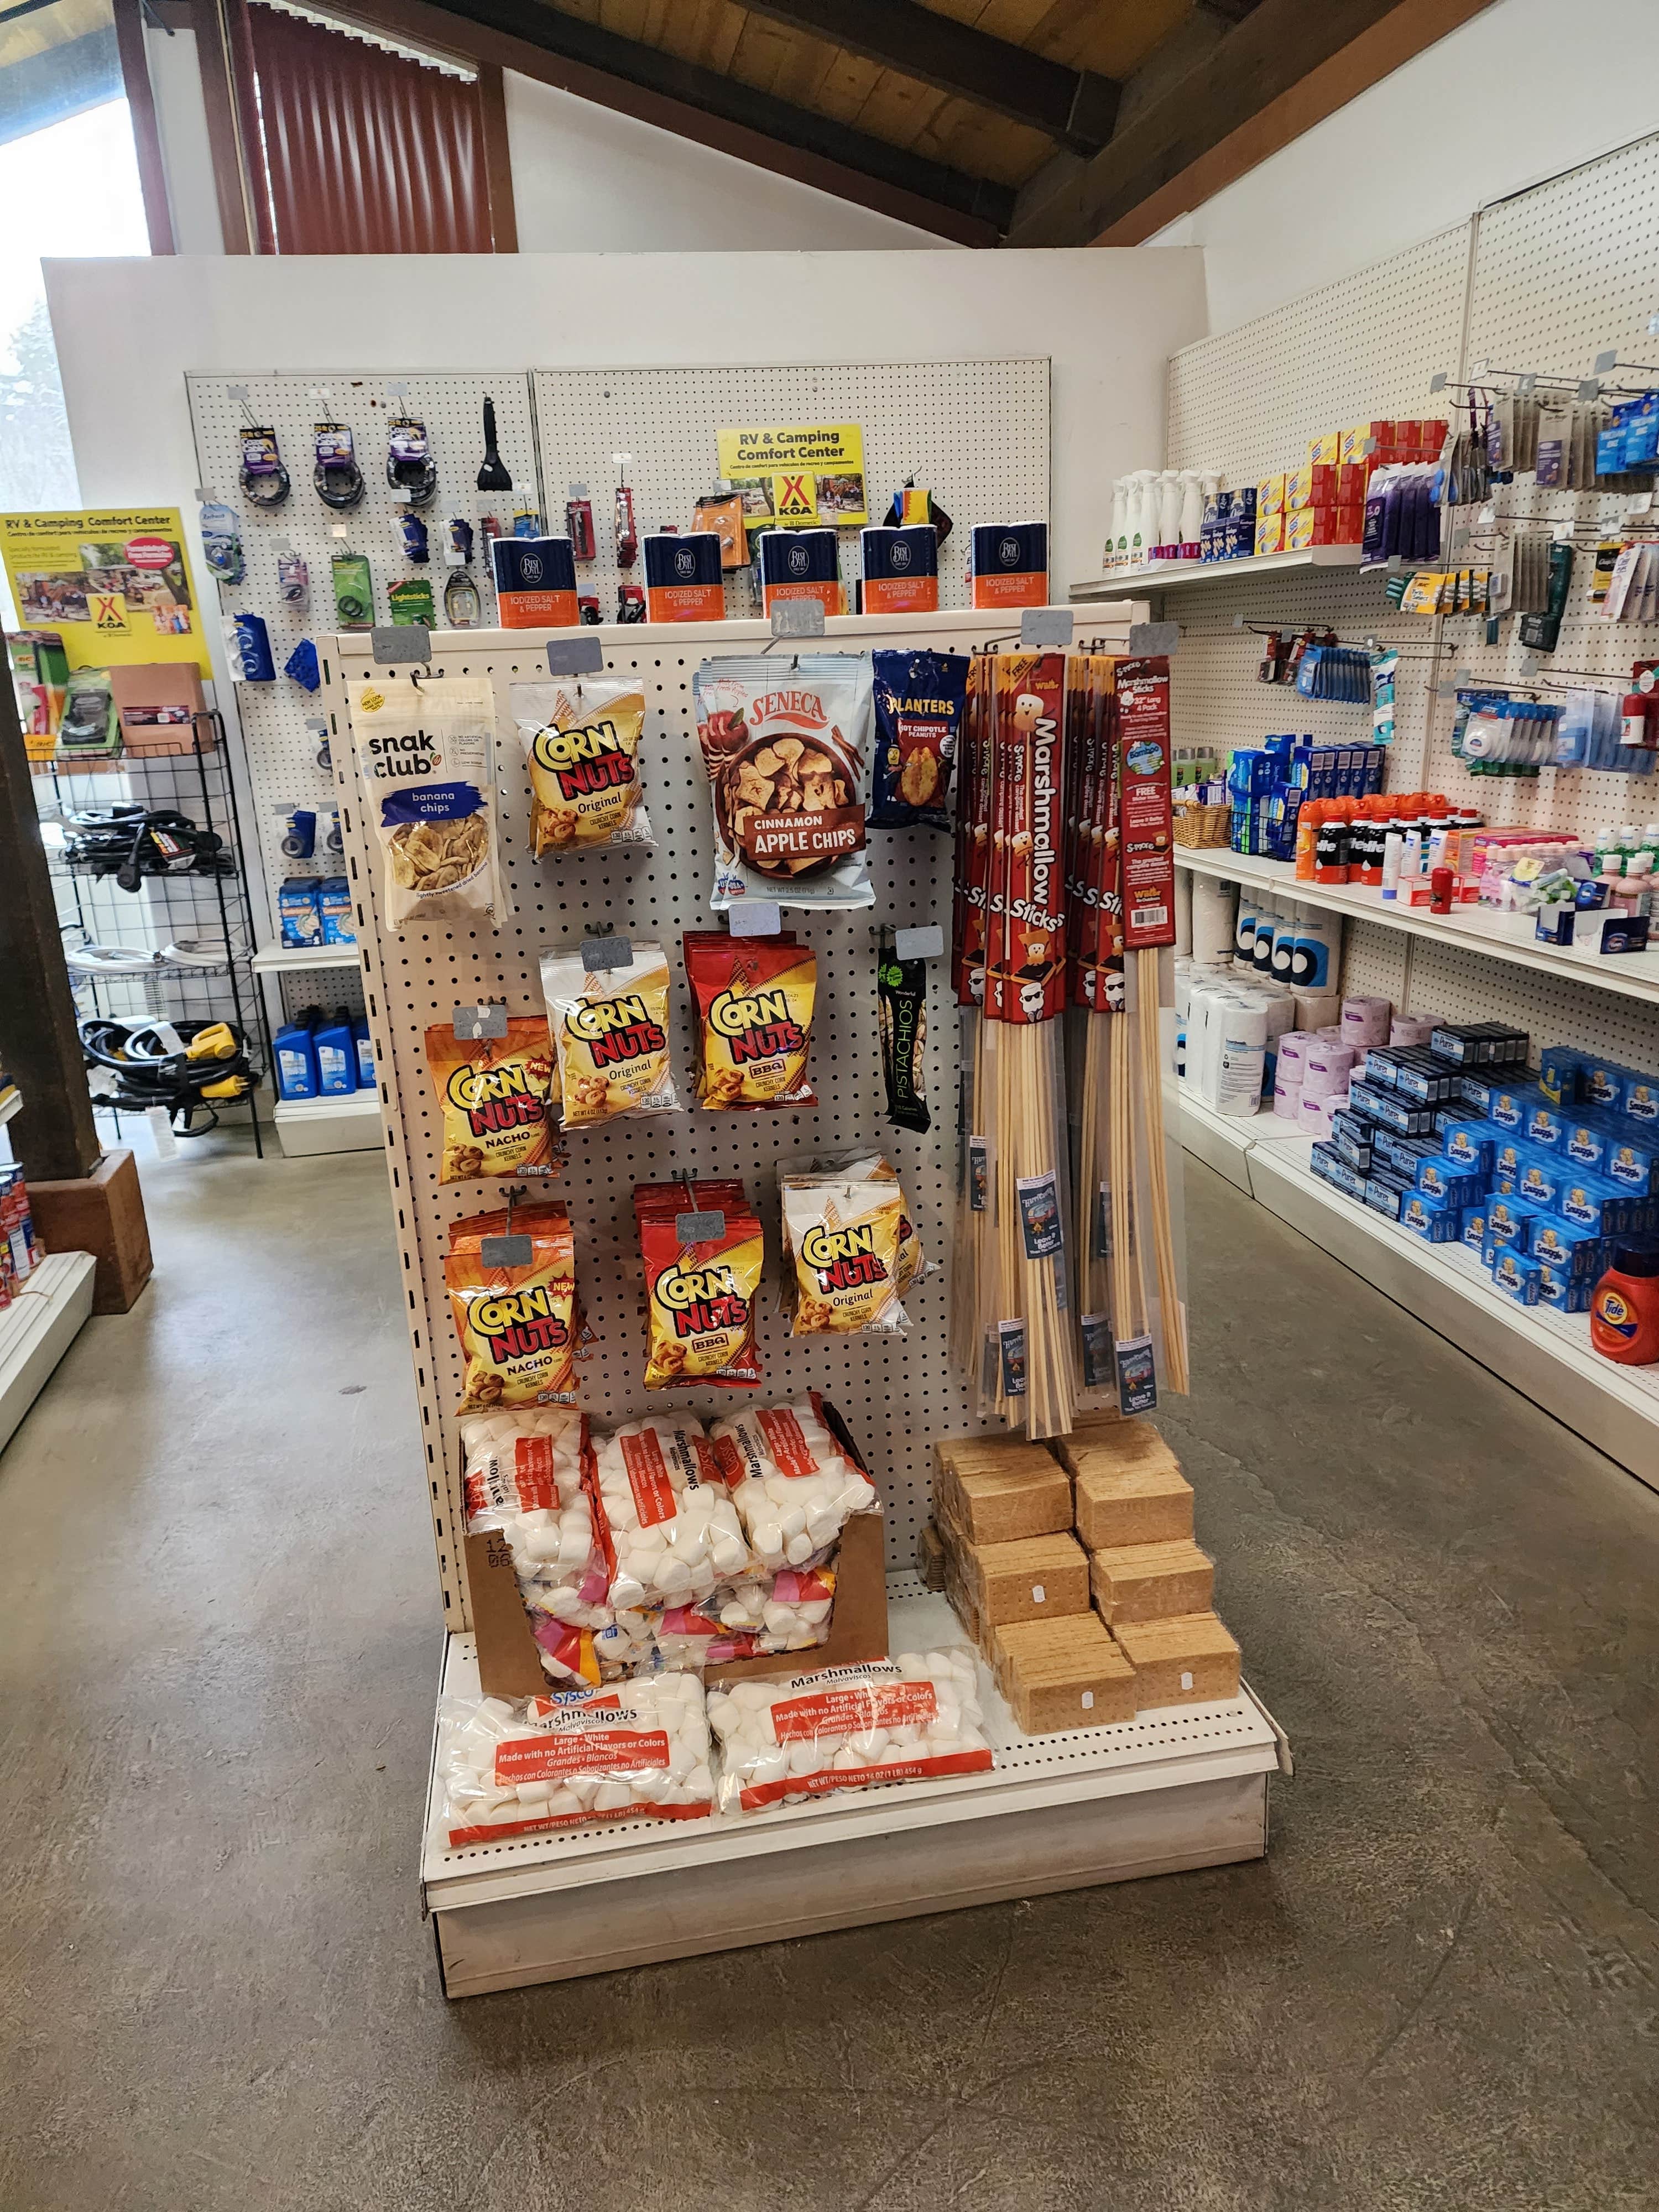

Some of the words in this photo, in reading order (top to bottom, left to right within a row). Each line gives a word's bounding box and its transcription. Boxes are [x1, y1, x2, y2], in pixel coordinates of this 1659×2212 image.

[740, 434, 759, 445] RV
[763, 433, 774, 444] &
[777, 431, 839, 445] Camping
[738, 448, 795, 460] Comfort
[799, 447, 844, 457] Center
[779, 507, 812, 515] KOA
[6, 520, 20, 529] RV
[35, 518, 83, 528] Camping
[88, 516, 133, 525] Comfort
[135, 516, 170, 525] Center
[776, 588, 805, 596] IODIZED
[806, 586, 824, 594] SALT
[878, 582, 906, 591] IODIZED
[907, 581, 925, 589] SALT
[893, 589, 916, 598] PEPPER
[510, 596, 540, 604] IODIZED
[541, 595, 561, 603] SALT
[1012, 658, 1028, 677] FREE
[1118, 676, 1168, 689] Marshmallow
[750, 691, 827, 726] SENECA
[890, 697, 954, 715] PLANTERS
[369, 730, 435, 754] snak
[535, 723, 618, 771] CORN
[1130, 746, 1159, 759] Bamboo
[374, 754, 431, 779] club
[559, 752, 633, 798] NUTS
[413, 792, 455, 802] banana
[1136, 786, 1156, 796] FREE
[420, 803, 450, 814] chips
[578, 792, 622, 813] Original
[1032, 718, 1056, 904] Marshmallow
[754, 816, 822, 830] CINNAMON
[755, 831, 808, 853] APPLE
[812, 829, 855, 849] CHIPS
[462, 876, 474, 886] dried
[474, 862, 488, 877] banana
[1010, 898, 1058, 932] Sticks
[567, 997, 646, 1040] CORN
[711, 992, 787, 1036] CORN
[591, 1022, 664, 1066] NUTS
[732, 1021, 802, 1062] NUTS
[896, 999, 912, 1099] PISTACHIOS
[1439, 1036, 1454, 1051] Purex
[530, 1062, 550, 1072] NEW
[609, 1060, 651, 1080] Original
[752, 1062, 782, 1076] BBQ
[449, 1067, 526, 1109] CORN
[620, 1081, 639, 1091] CRUNCHY
[629, 1086, 646, 1094] KERNELS
[1405, 1073, 1419, 1089] Purex
[470, 1094, 540, 1135] NUTS
[1385, 1105, 1400, 1121] Purex
[485, 1131, 530, 1149] NACHO
[1450, 1145, 1472, 1160] Snuggle
[1571, 1143, 1595, 1159] Snuggle
[1613, 1162, 1640, 1179] Snuggle
[1566, 1203, 1592, 1220] Snuggle
[1406, 1213, 1426, 1229] Snuggle
[803, 1227, 873, 1267] CORN
[820, 1254, 888, 1292] NUTS
[554, 1282, 575, 1291] NEW
[656, 1267, 732, 1310] CORN
[833, 1289, 873, 1306] Original
[469, 1288, 549, 1335] CORN
[676, 1295, 747, 1335] NUTS
[1605, 1300, 1624, 1316] Tide
[492, 1317, 566, 1362] NUTS
[695, 1337, 726, 1350] BBQ
[507, 1356, 552, 1376] NACHO
[673, 1430, 699, 1490] Marshmallows
[720, 1442, 739, 1475] Classic
[734, 1424, 764, 1478] Marshmallows
[636, 1498, 648, 1524] Artificiales
[654, 1498, 665, 1519] Colors
[791, 1665, 902, 1689] Marshmallows
[826, 1674, 871, 1685] Malvaviscos
[776, 1713, 797, 1723] Made
[799, 1708, 816, 1717] with
[830, 1702, 865, 1713] Artificial
[907, 1692, 933, 1702] Colors
[826, 1694, 849, 1704] Large
[554, 1737, 578, 1745] Large
[499, 1754, 522, 1763] Made
[524, 1751, 542, 1760] with
[557, 1744, 594, 1755] Artificial
[596, 1741, 626, 1750] Flavors
[547, 1755, 580, 1767] Grandes
[587, 1753, 617, 1761] Blancos
[537, 1769, 572, 1779] Colorantes
[578, 1764, 620, 1773] Saborizantes
[631, 1759, 665, 1768] Artificiales
[808, 1780, 818, 1788] NET
[820, 1776, 847, 1787] WT/PESO
[848, 1773, 865, 1782] NETO
